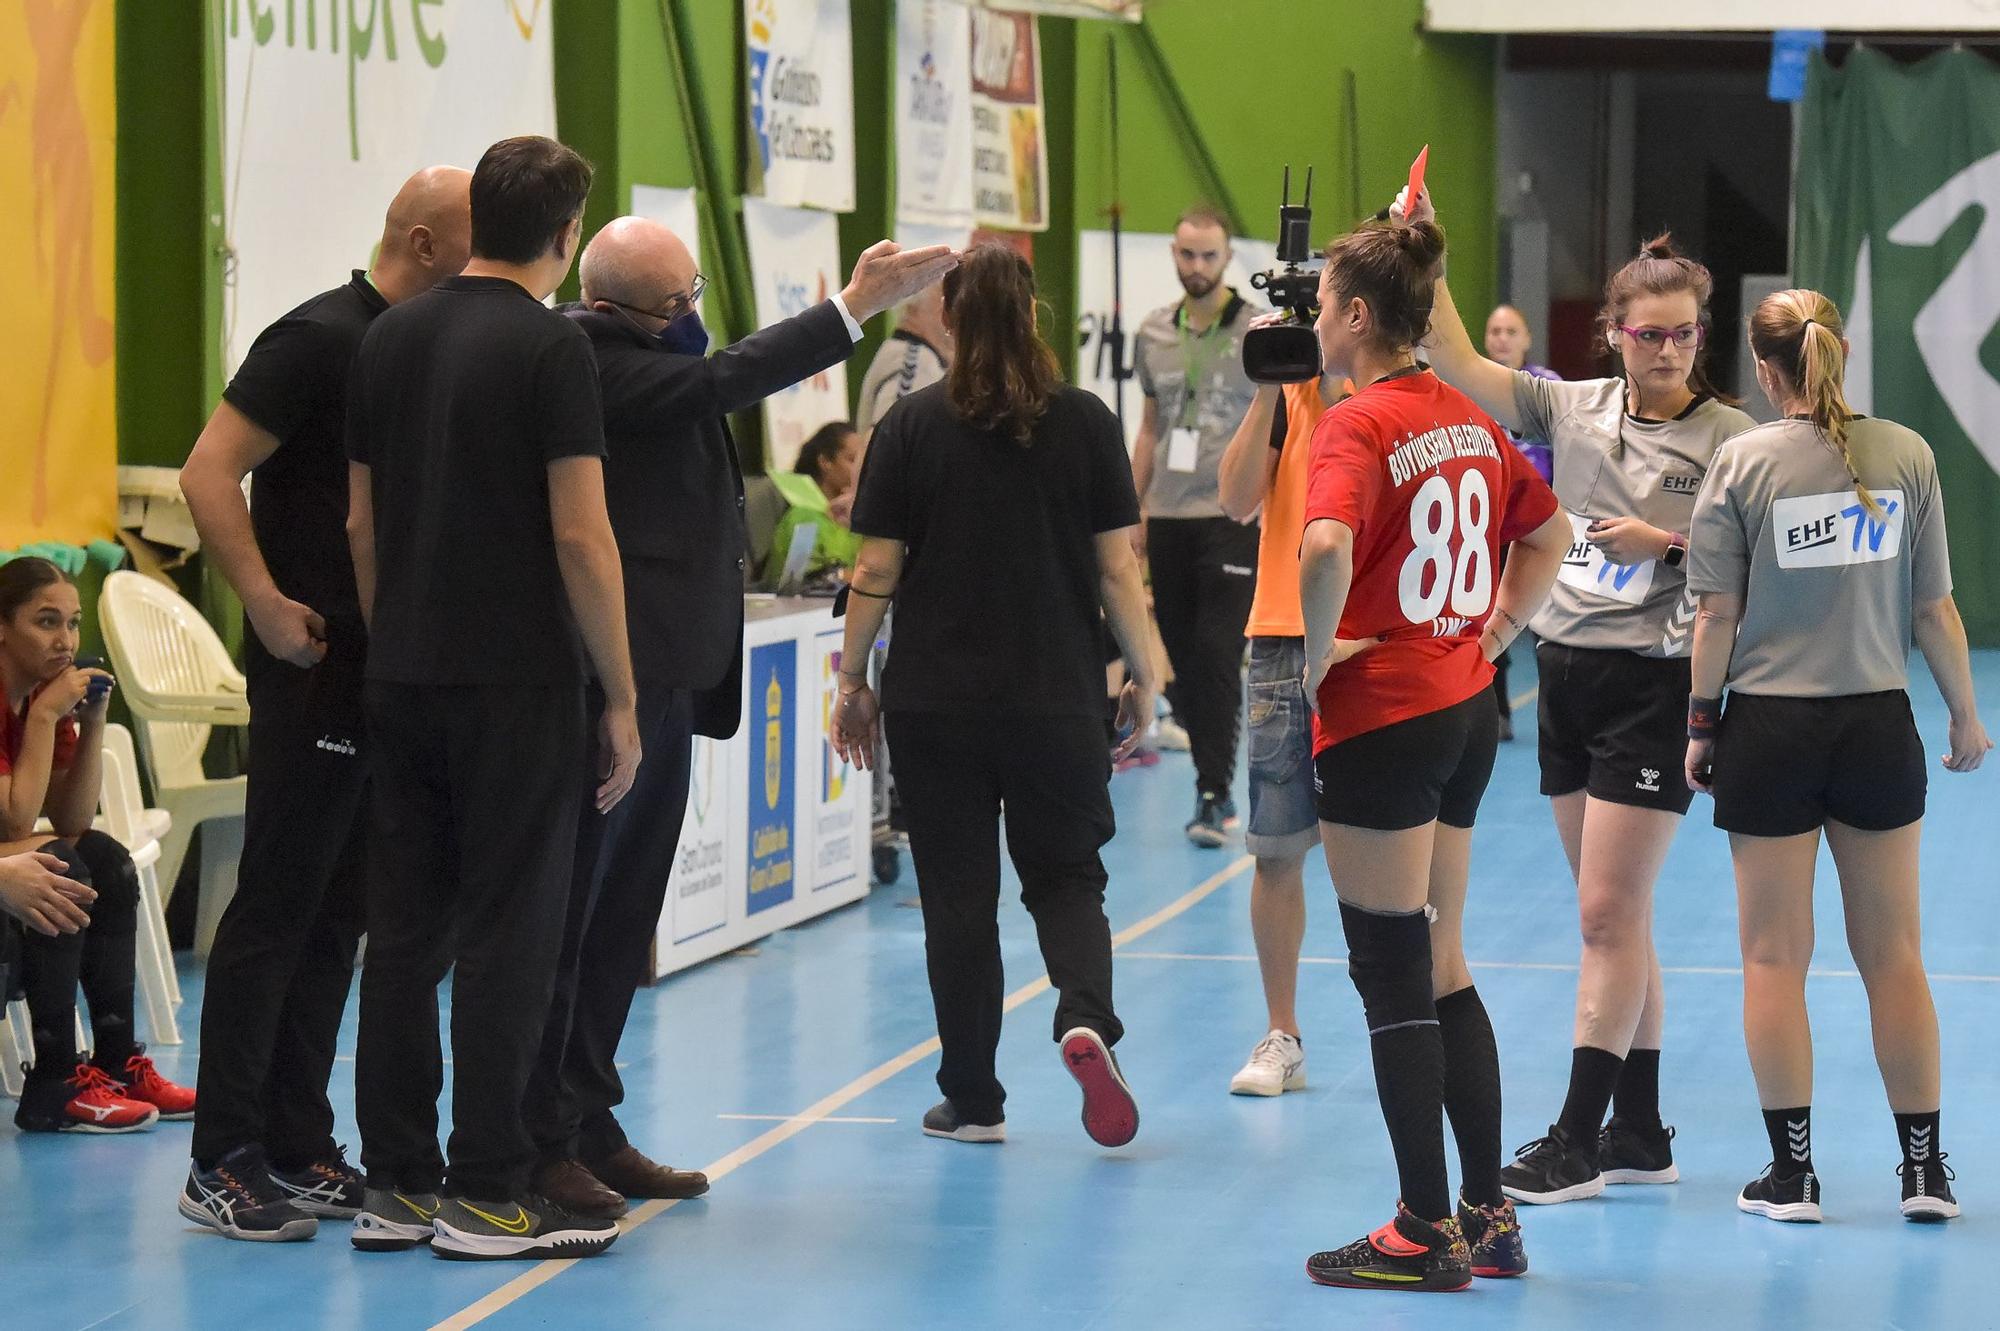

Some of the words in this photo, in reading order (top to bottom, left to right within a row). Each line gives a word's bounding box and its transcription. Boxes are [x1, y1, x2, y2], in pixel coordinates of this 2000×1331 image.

[1662, 476, 1700, 489] EHF
[1398, 468, 1491, 625] 88
[1787, 514, 1837, 547] EHF
[1841, 498, 1898, 553] TV
